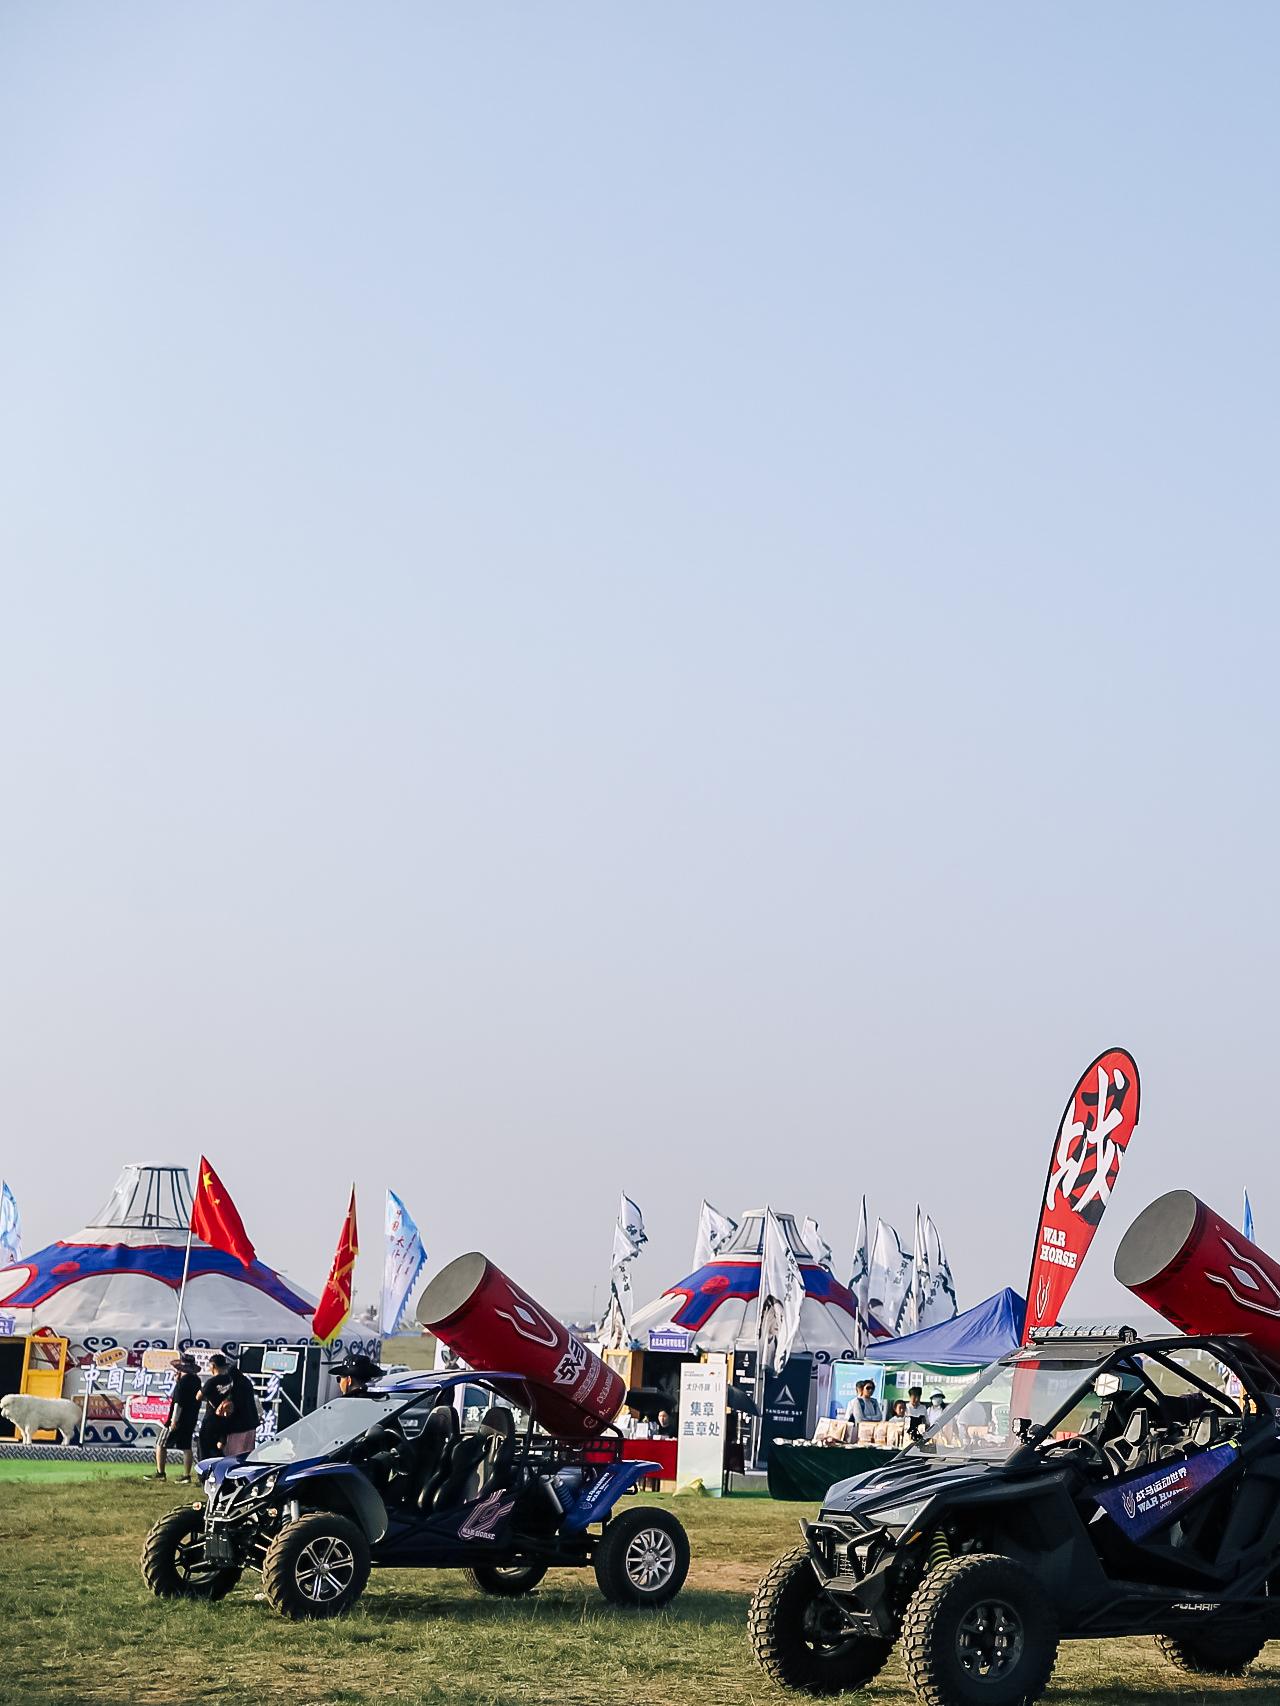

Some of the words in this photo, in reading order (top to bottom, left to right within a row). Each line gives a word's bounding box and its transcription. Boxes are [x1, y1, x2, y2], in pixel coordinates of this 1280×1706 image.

[1042, 1226, 1066, 1247] WAR
[1039, 1245, 1078, 1269] HORSE
[690, 1401, 714, 1416] 集章
[683, 1421, 720, 1437] 盖章处
[1136, 1467, 1187, 1502] 战马运动世界
[1137, 1496, 1159, 1513] WAR
